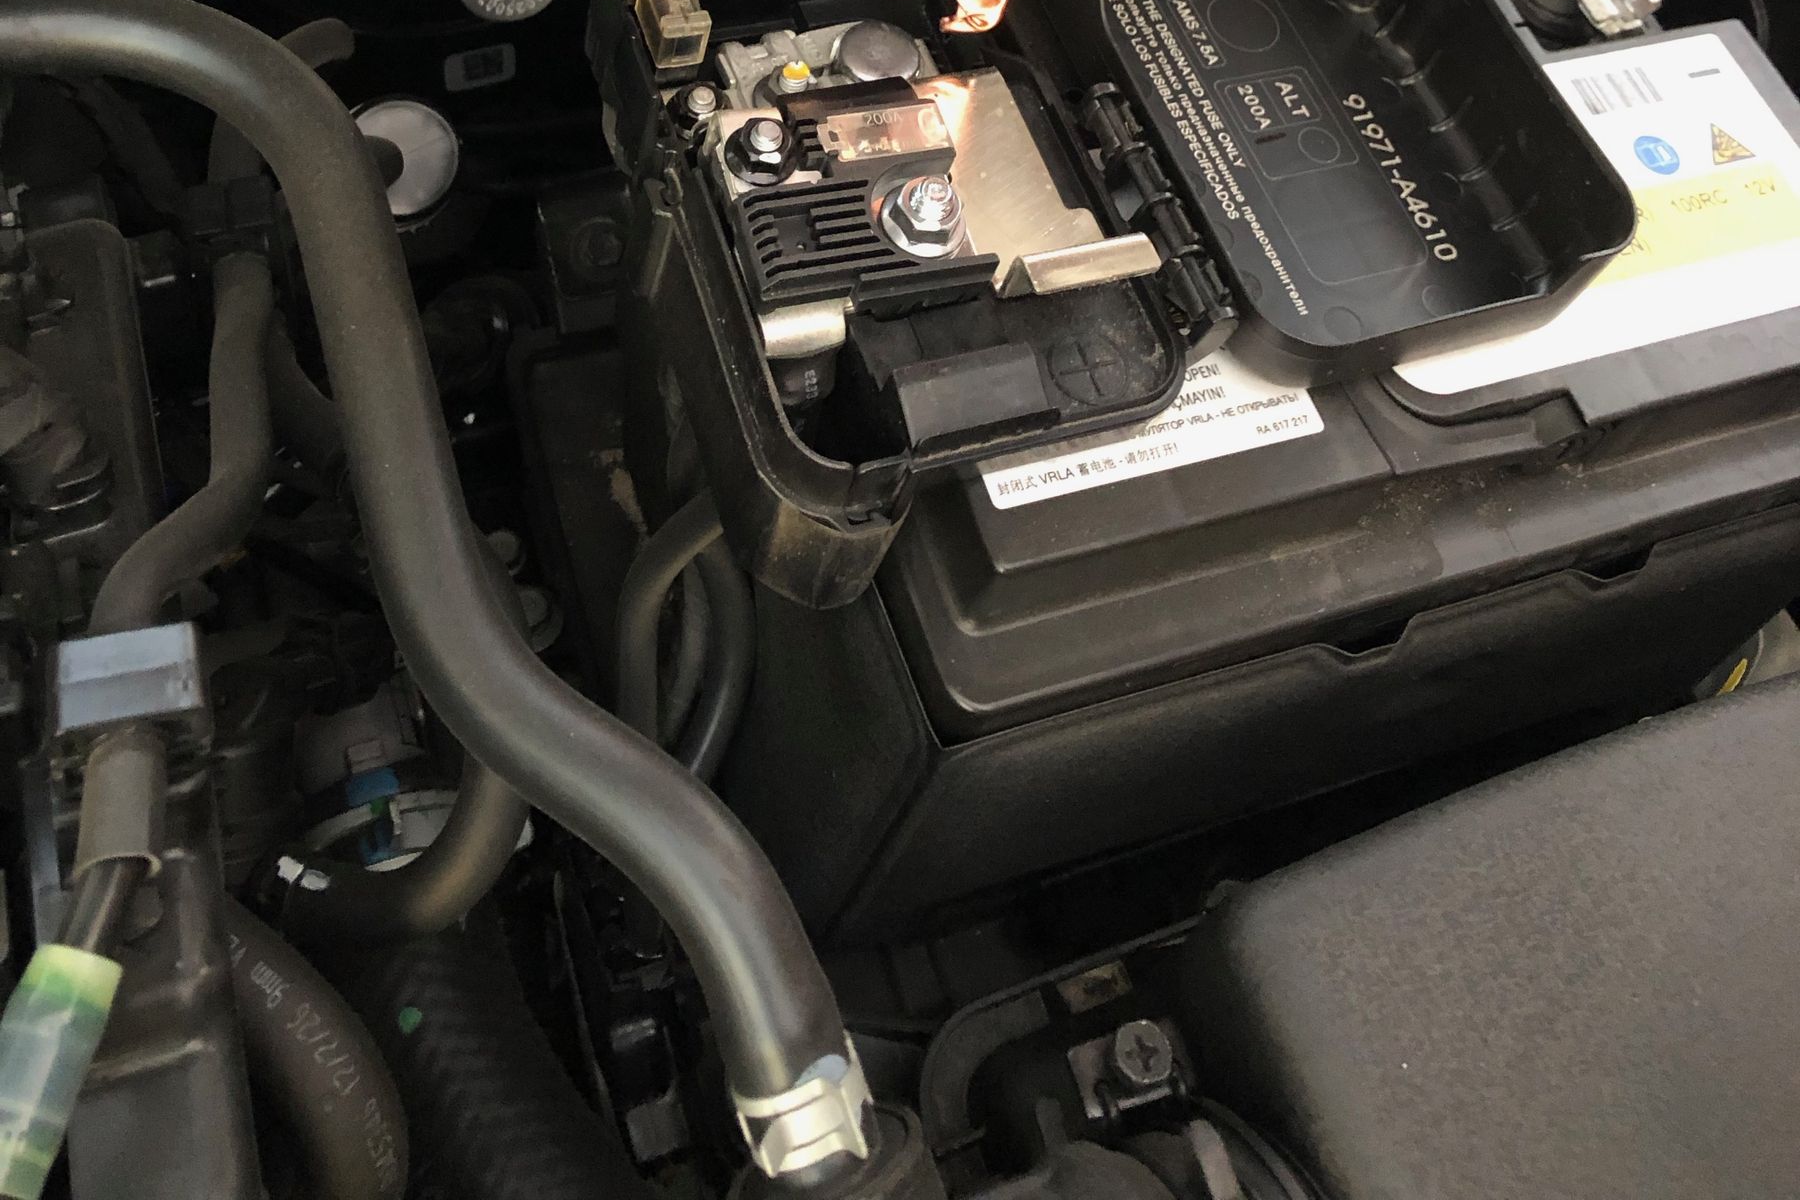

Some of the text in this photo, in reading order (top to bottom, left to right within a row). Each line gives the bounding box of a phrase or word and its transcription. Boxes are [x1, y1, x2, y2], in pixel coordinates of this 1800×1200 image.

[1172, 0, 1200, 32] AMS
[1113, 3, 1137, 36] SOLO
[1131, 37, 1152, 62] LOS
[1144, 63, 1183, 119] FUSIBLES
[1176, 120, 1241, 220] ESPECIFICADOS
[1155, 23, 1205, 98] DESIGNATED
[1198, 99, 1224, 131] FUSE
[1217, 132, 1247, 169] ONLY
[1237, 84, 1272, 130] 200A
[1274, 81, 1311, 118] ALT
[1155, 50, 1182, 91] только
[1177, 93, 1246, 203] предназначенные
[1241, 205, 1309, 316] предохранители
[1342, 93, 1458, 262] 91971-A4610
[1670, 189, 1728, 213] 100RC
[1184, 363, 1221, 382] OPEN!
[1170, 385, 1226, 411] ÇMAYIN!
[1187, 412, 1214, 425] VRLA
[1255, 414, 1308, 435] RA 617 217
[1038, 467, 1076, 485] VRLA
